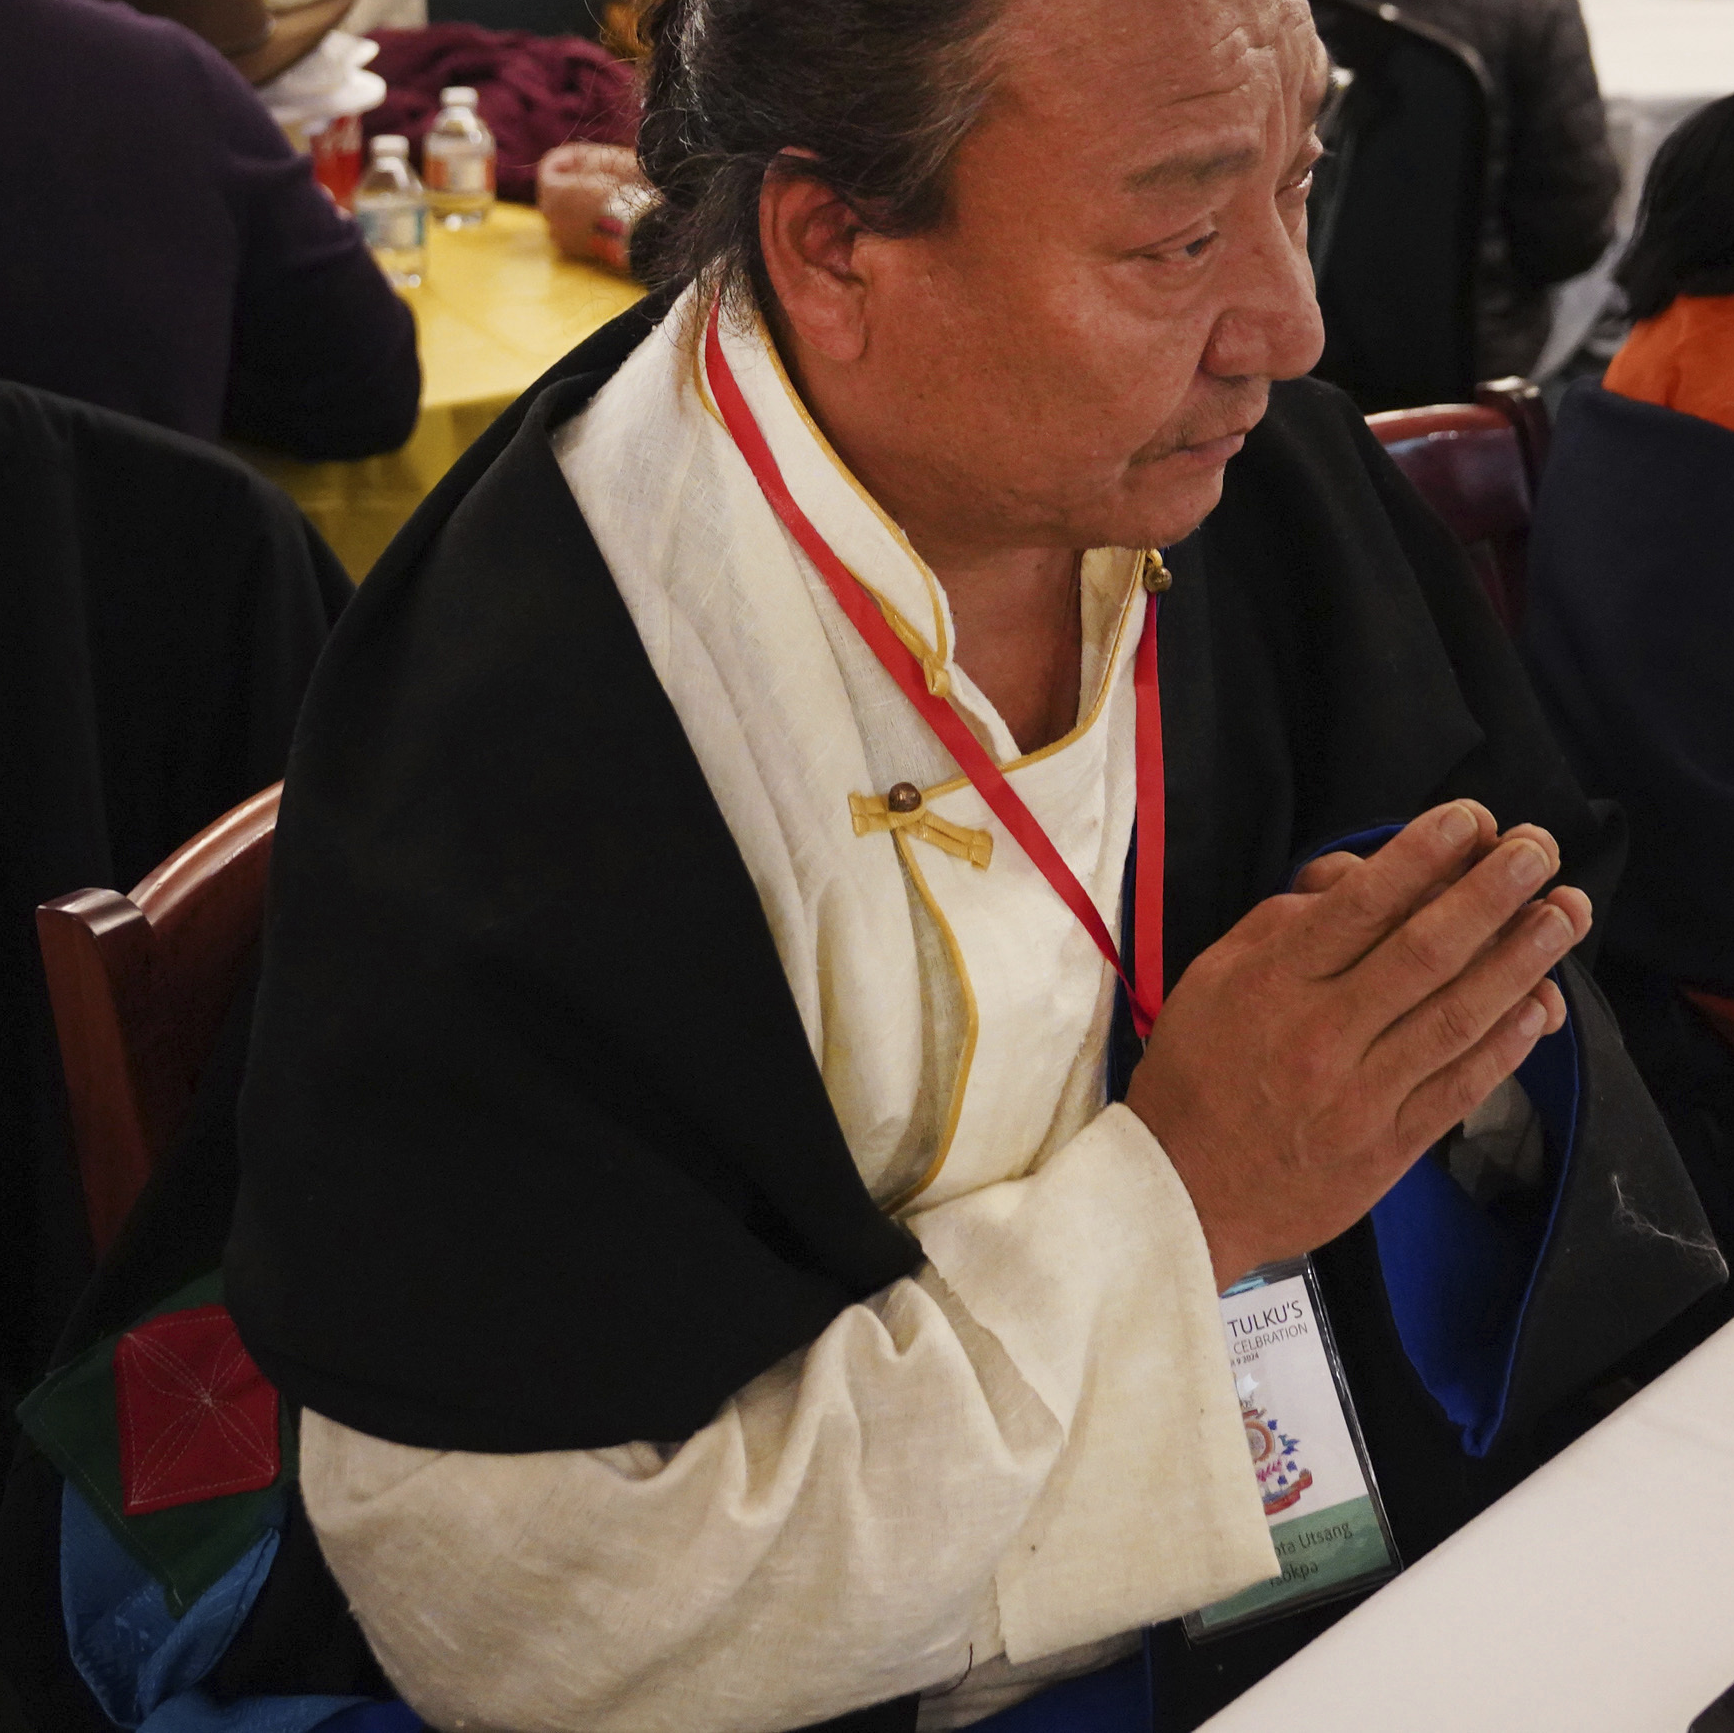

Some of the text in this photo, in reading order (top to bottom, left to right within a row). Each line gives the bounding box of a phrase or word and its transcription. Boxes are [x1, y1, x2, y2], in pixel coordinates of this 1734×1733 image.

[1227, 1300, 1303, 1338] TULKU'S
[1233, 1322, 1308, 1355] CELBRATION
[1243, 1351, 1260, 1363] 2024
[1298, 1522, 1353, 1549] Utsang
